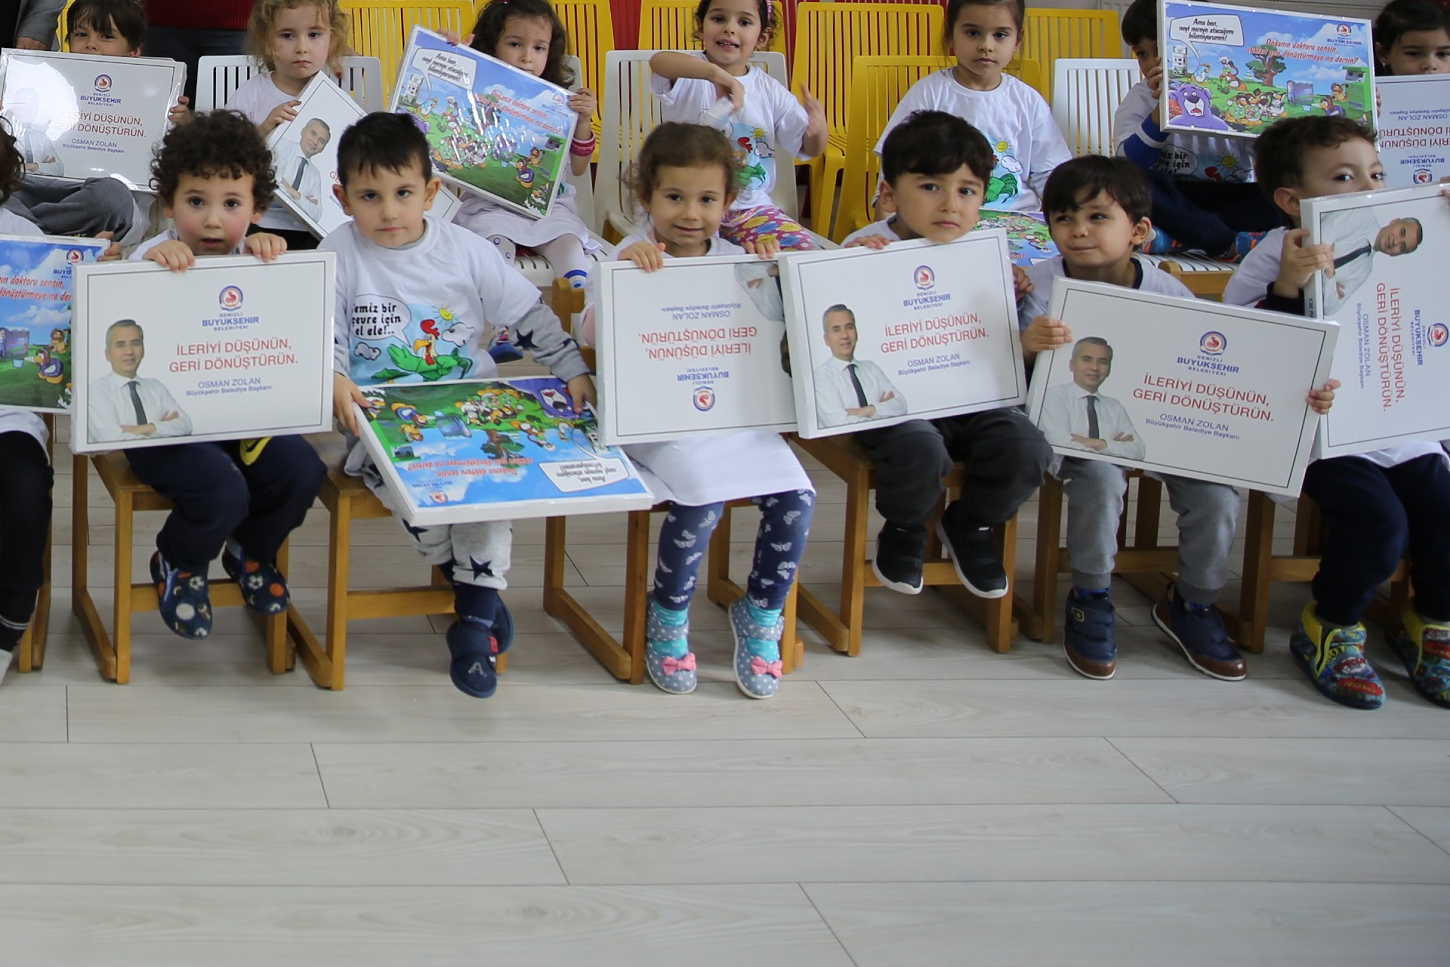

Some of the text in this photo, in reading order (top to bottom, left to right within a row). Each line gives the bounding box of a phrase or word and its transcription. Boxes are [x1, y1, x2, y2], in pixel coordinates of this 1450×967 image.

[93, 113, 143, 126] DÜŞÜNÜN,
[78, 123, 147, 138] DÖNÜŞTÜRÜN.
[1379, 126, 1442, 139] DÖNÜŞTÜRÜ
[71, 138, 117, 148] OSMAN ZOLAN
[1380, 138, 1427, 150] DÜŞÜNÜN
[382, 303, 397, 312] bir
[672, 310, 731, 320] OSMAN ZOLAN
[381, 314, 401, 326] için
[885, 312, 981, 337] İLERİYİ DÜŞÜNÜN,
[1362, 313, 1370, 345] OSMAN
[355, 326, 363, 335] el
[638, 326, 758, 345] GERİ DÖNÜŞTÜRÜN.
[177, 337, 292, 356] İLERİYİ DÜŞÜNÜN,
[880, 327, 989, 354] GERİ DÖNÜŞTÜRÜN.
[1376, 283, 1392, 412] GERİ DÖNÜŞTÜRÜN.
[1390, 288, 1406, 403] İLERİYİ DÜŞÜNÜN,
[645, 343, 751, 361] İLERİYİ DÜŞÜNÜN,
[907, 353, 960, 368] OSMAN ZOLAN
[169, 352, 298, 373] GERİ DÖNÜŞTÜRÜN.
[198, 377, 261, 389] OSMAN ZOLAN
[1144, 372, 1270, 407] İLERİYİ DÜŞÜNÜN,
[1133, 388, 1274, 422] GERİ DÖNÜŞTÜRÜN.
[1160, 413, 1229, 432] OSMAN ZOLAN
